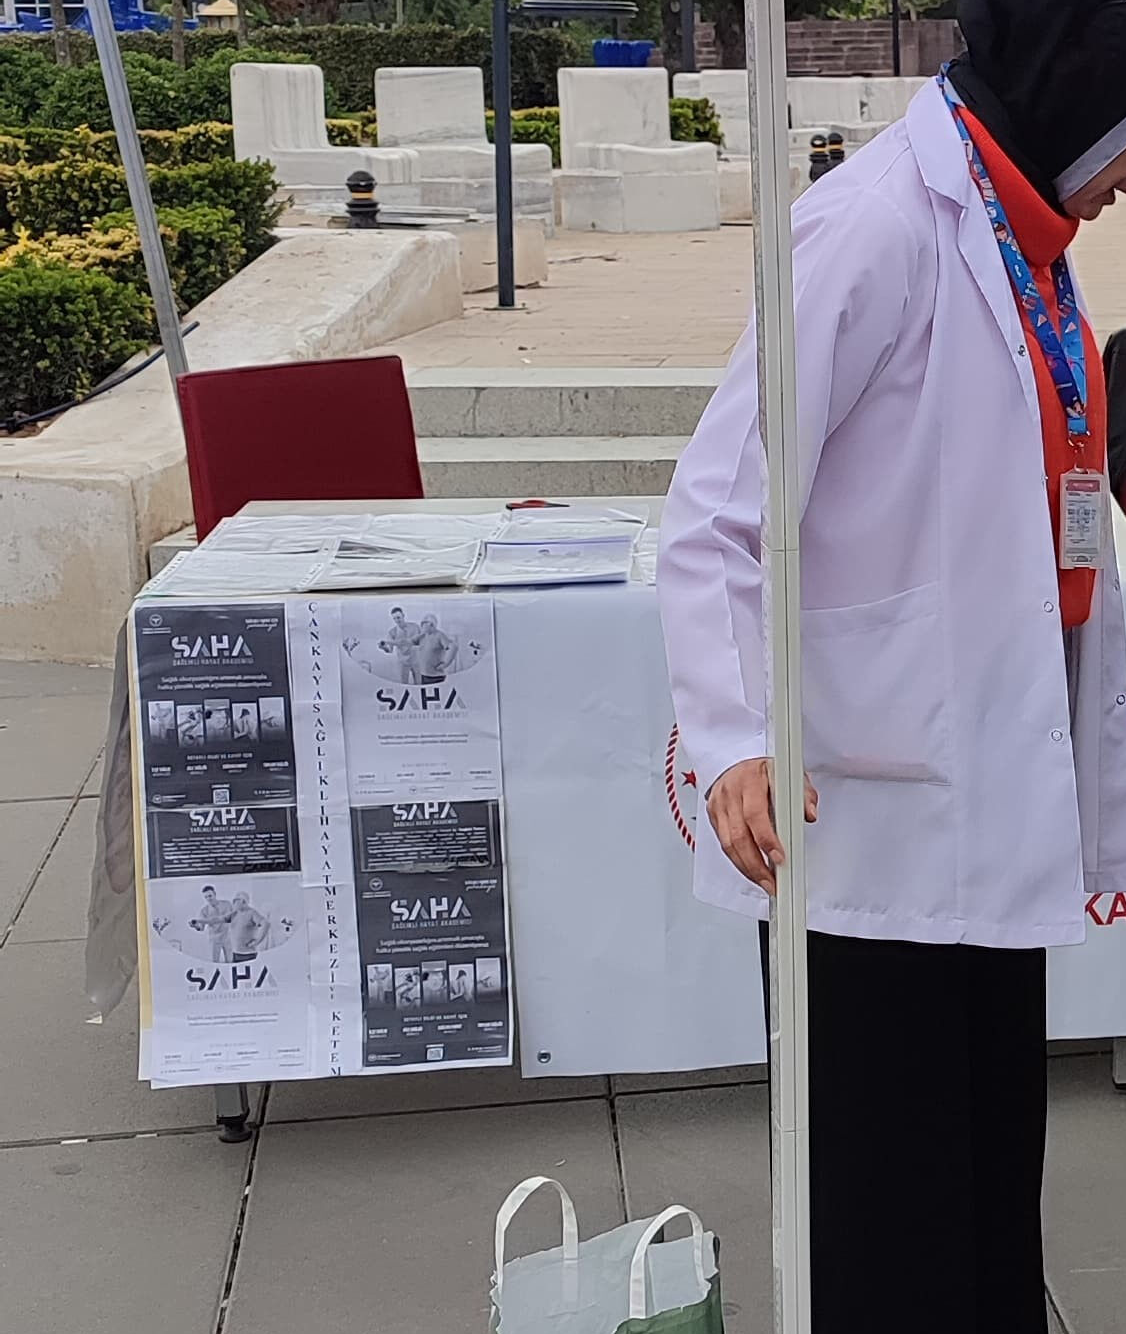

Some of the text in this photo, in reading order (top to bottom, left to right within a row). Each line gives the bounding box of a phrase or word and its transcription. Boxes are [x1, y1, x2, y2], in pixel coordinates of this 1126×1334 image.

[171, 635, 252, 657] SAHA
[376, 688, 466, 712] SAHA
[189, 808, 255, 826] SAHA
[393, 802, 457, 820] SAHA
[390, 897, 471, 921] SAHA
[186, 966, 277, 991] SAHA
